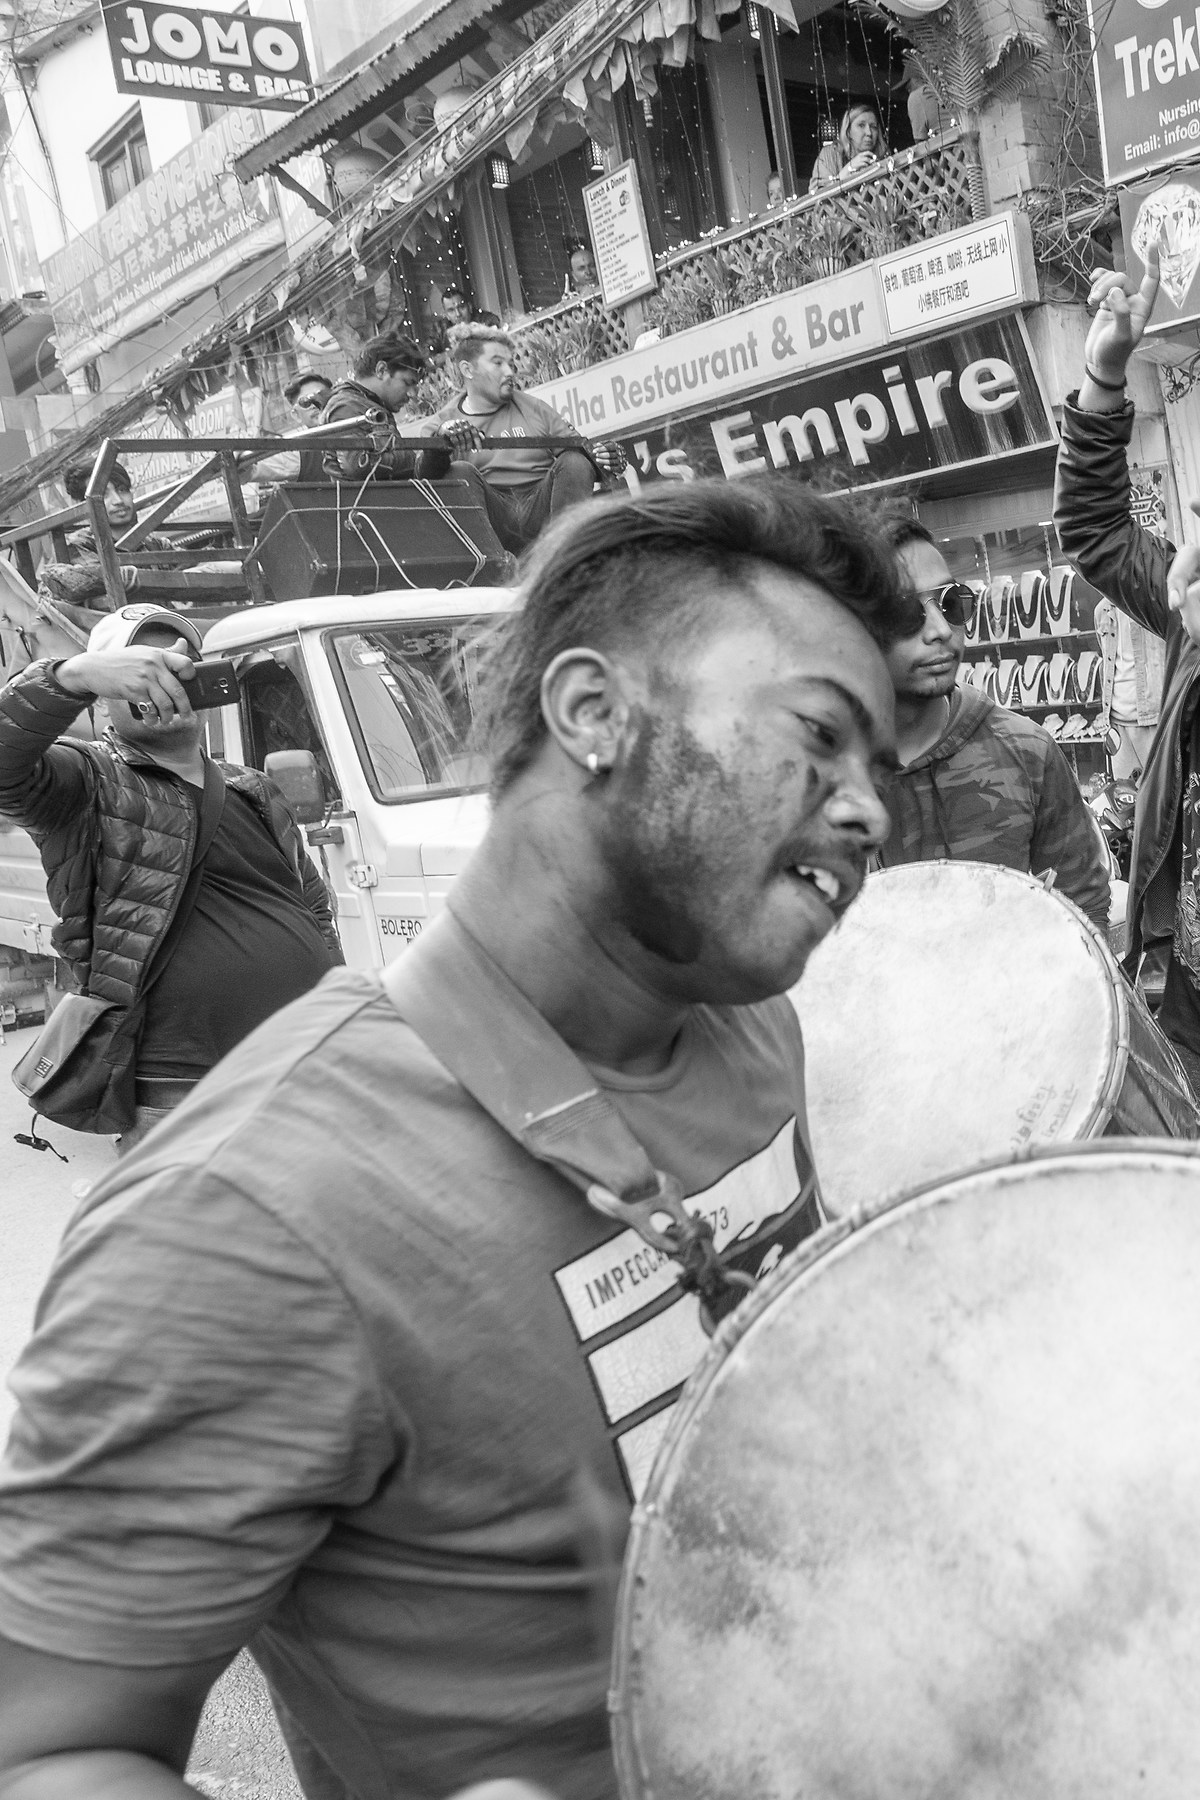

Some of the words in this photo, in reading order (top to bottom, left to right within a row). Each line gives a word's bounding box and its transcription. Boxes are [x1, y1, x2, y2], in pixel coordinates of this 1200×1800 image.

[120, 7, 299, 72] JOMO
[121, 58, 224, 92] LOUNGE
[228, 72, 250, 93] &
[254, 74, 310, 103] BAR
[1124, 134, 1162, 161] Email:
[146, 150, 198, 227] SPICE
[589, 184, 605, 202] Lunch
[610, 173, 628, 190] Dinner
[551, 387, 606, 427] dha
[611, 331, 758, 414] Restaurant
[771, 315, 798, 361] &
[805, 301, 864, 349] Bar
[709, 357, 1021, 481] Empire
[380, 919, 422, 937] BOLERO
